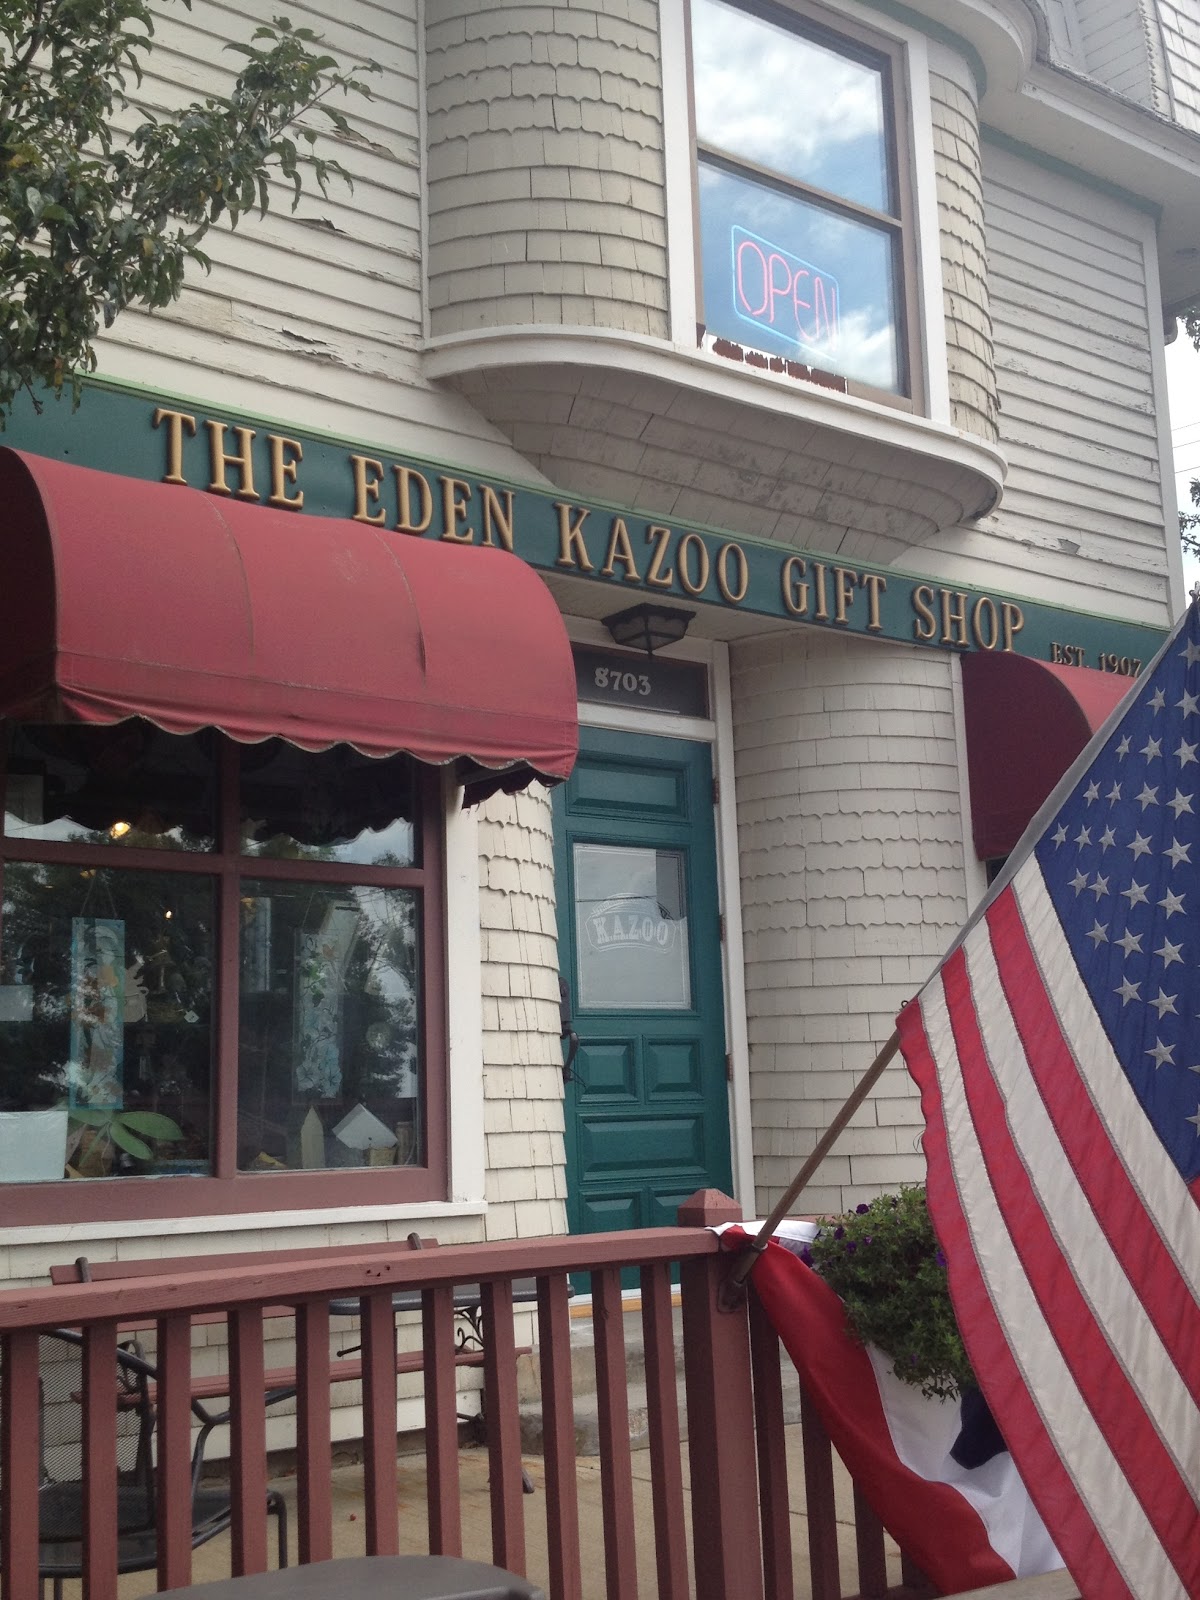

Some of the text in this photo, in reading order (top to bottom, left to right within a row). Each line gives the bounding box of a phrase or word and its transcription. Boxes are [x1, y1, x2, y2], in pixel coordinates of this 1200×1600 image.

[738, 241, 836, 350] OPEN
[153, 408, 1025, 652] THE EDEN KAZOO GIFT SHOP
[1099, 652, 1142, 678] 1907
[594, 667, 651, 696] 8703
[592, 914, 669, 946] KAZOO
